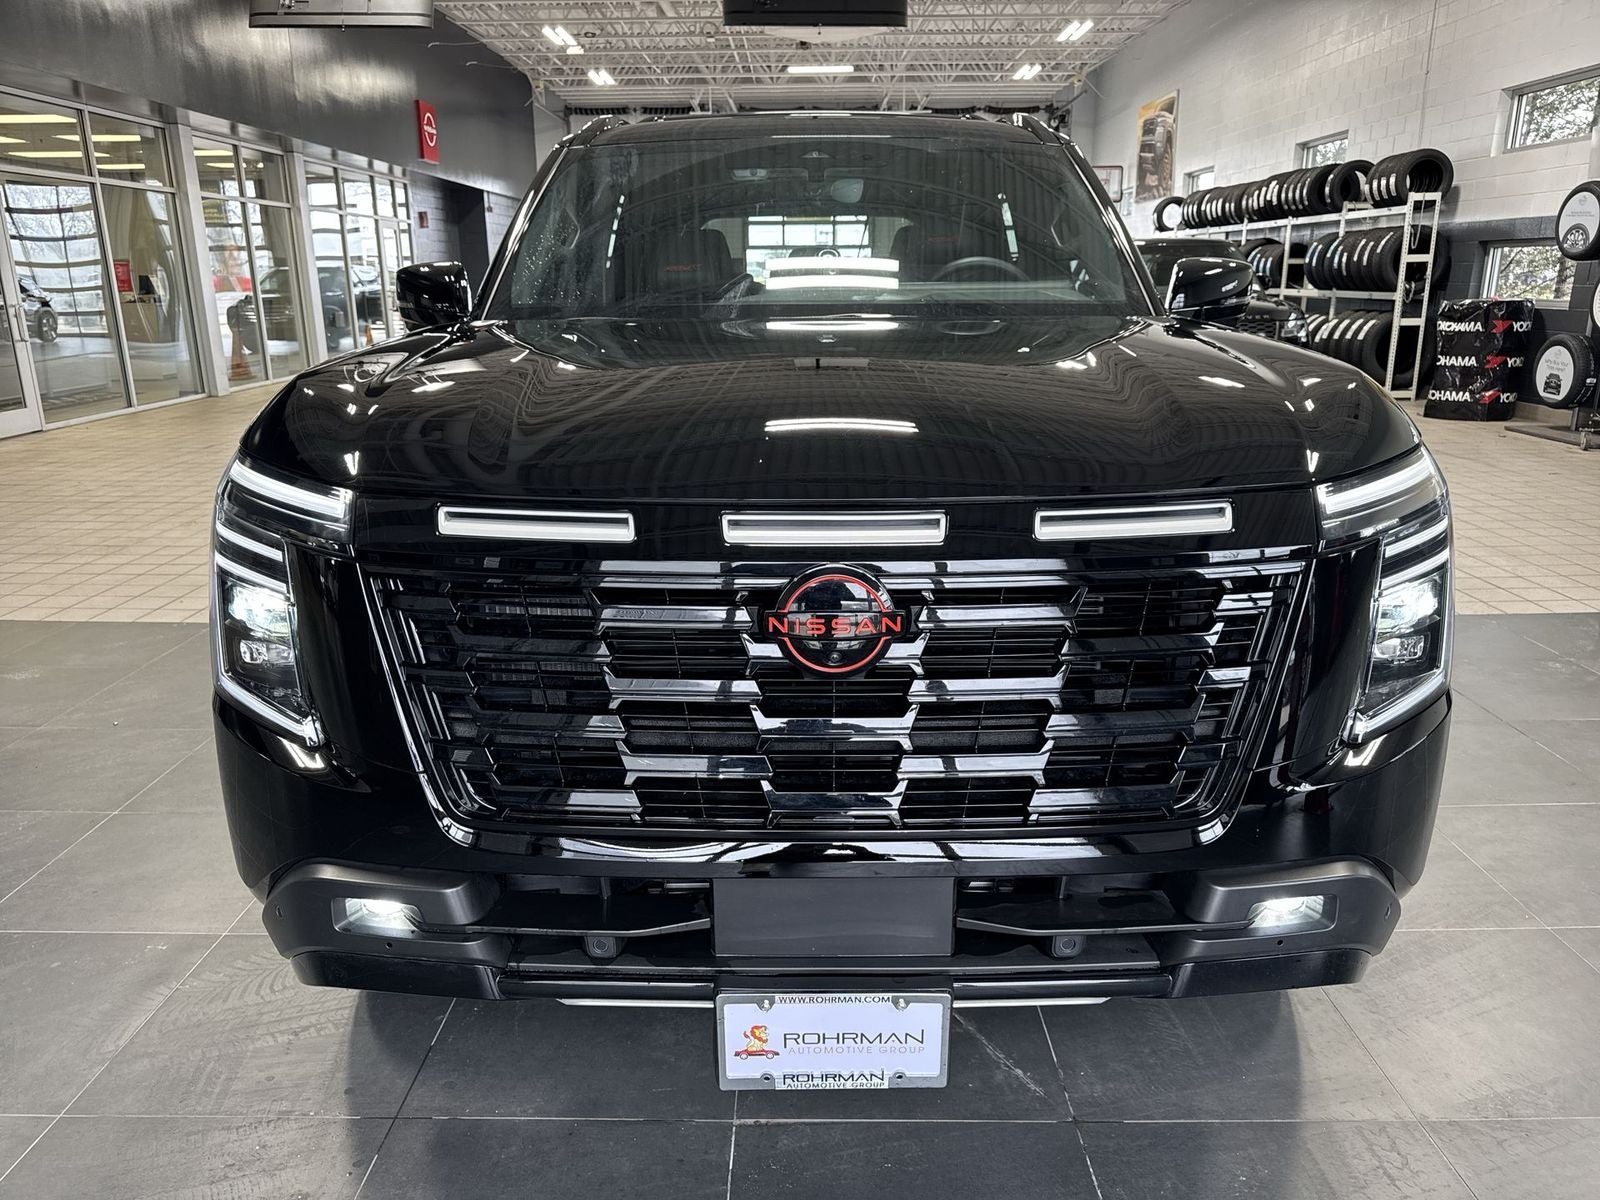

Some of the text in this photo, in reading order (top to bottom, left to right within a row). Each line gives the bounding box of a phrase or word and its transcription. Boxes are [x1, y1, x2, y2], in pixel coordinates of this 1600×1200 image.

[767, 616, 902, 634] NISSAN
[778, 995, 891, 1004] WWW.ROHRMAN.COM
[783, 1029, 925, 1048] ROHRMAN
[788, 1046, 925, 1054] AUTOMOTIVE GROUP
[783, 1069, 885, 1085] ROHRMAN
